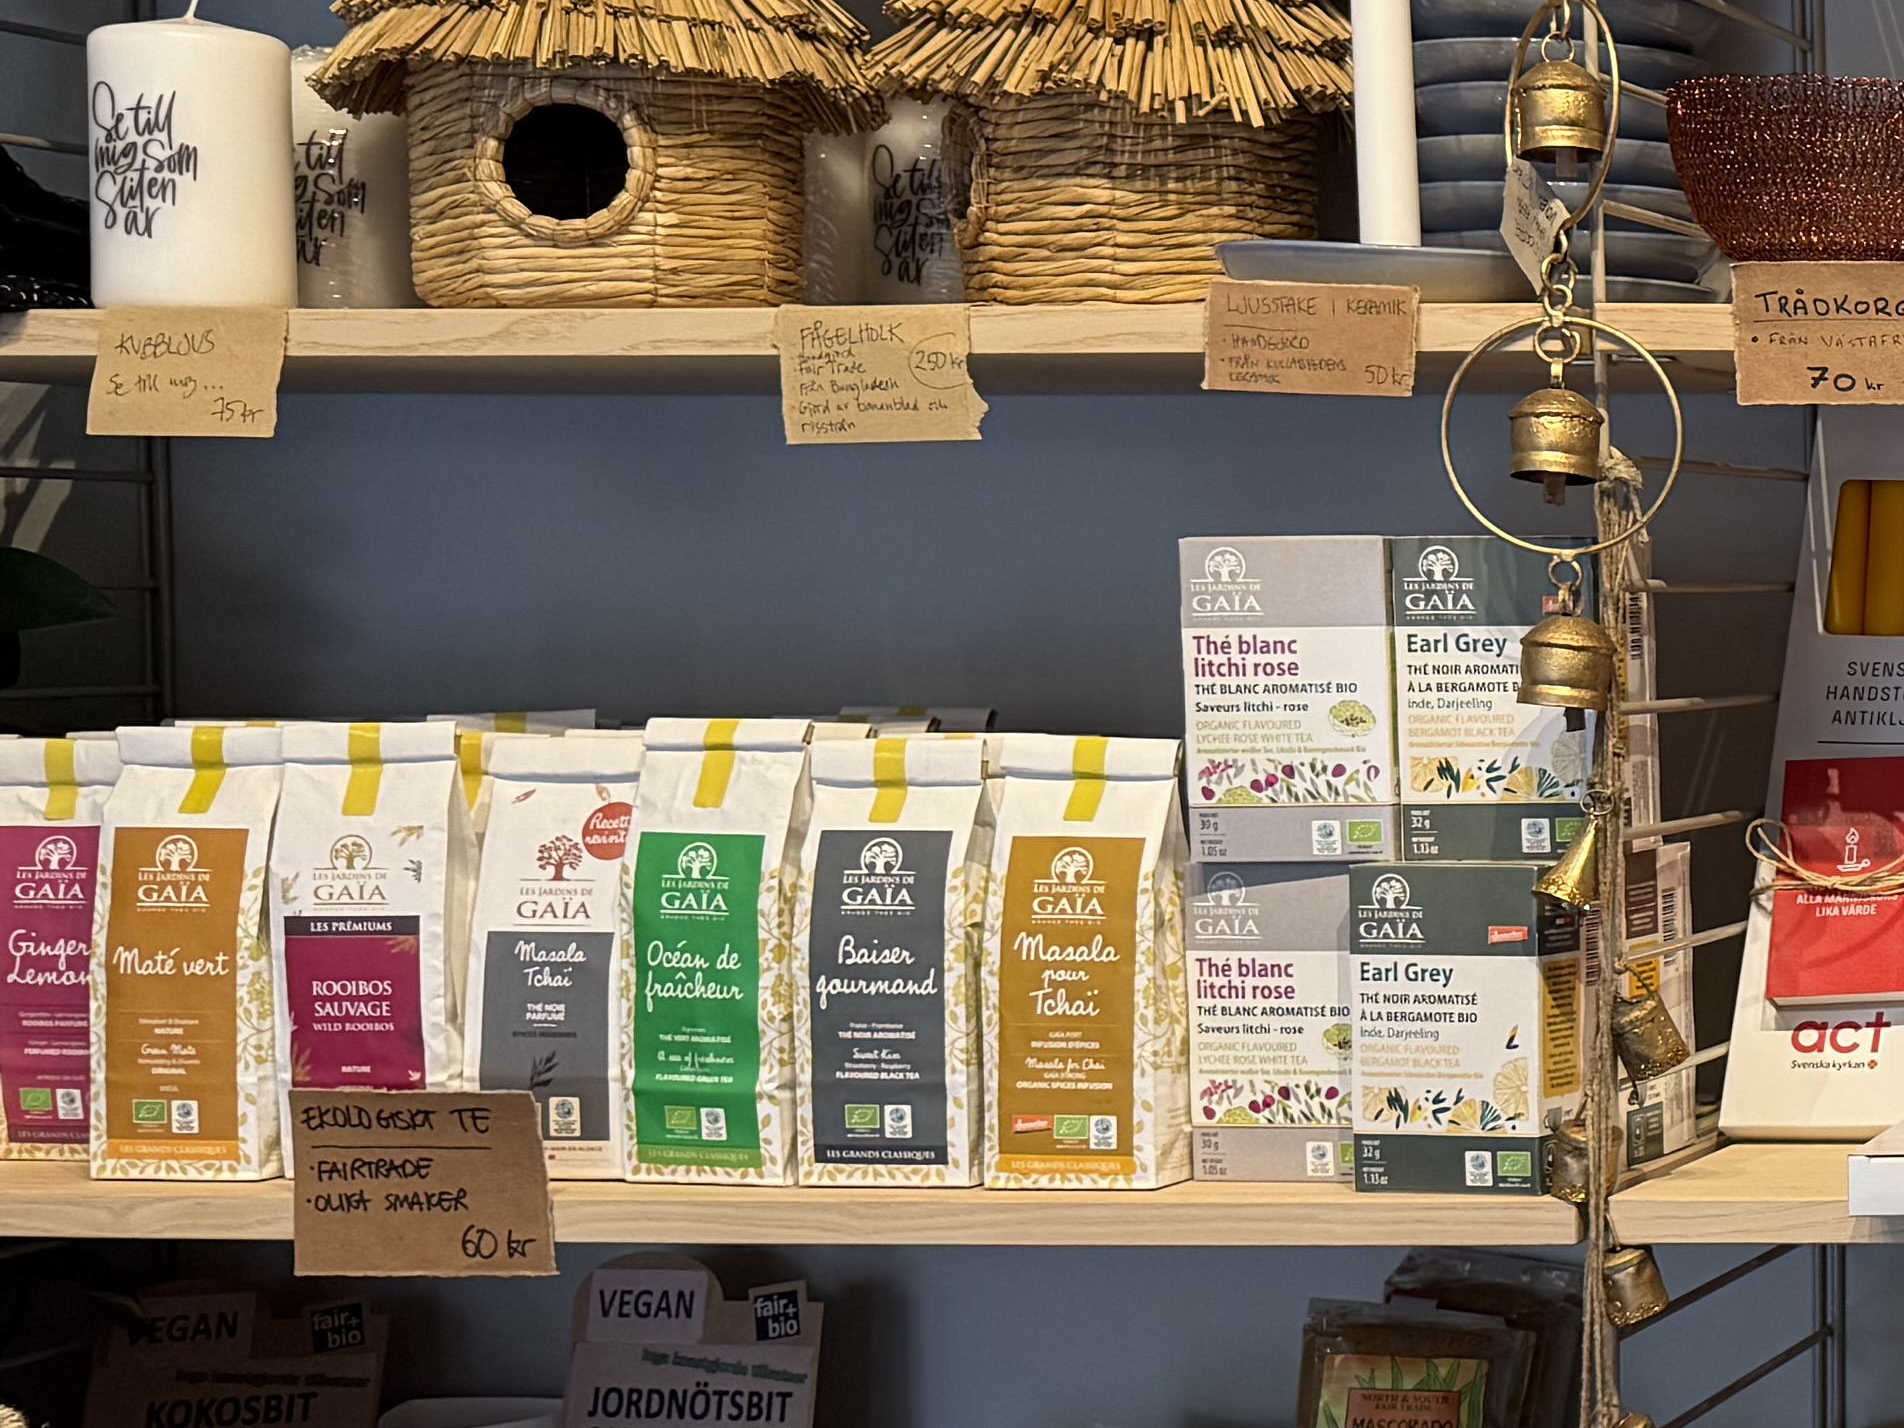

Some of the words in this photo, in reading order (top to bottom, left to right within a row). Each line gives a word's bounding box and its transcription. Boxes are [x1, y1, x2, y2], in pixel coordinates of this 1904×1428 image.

[134, 90, 177, 143] till
[125, 205, 160, 239] är
[800, 320, 905, 348] FÅGELHOLK
[1768, 331, 1810, 345] FRÅN
[1805, 365, 1858, 393] 70
[1864, 378, 1885, 391] kr
[1192, 592, 1263, 613] GAÏA
[1192, 634, 1232, 656] Thé
[1237, 634, 1298, 656] blanc
[1194, 656, 1249, 677] litchi
[1252, 660, 1300, 677] rose
[1262, 679, 1333, 695] AROMATISÉ
[1336, 683, 1357, 695] BIO
[1815, 904, 1839, 917] LIKA
[1841, 902, 1877, 916] VÄRDE
[331, 919, 392, 933] PRÉMIUMS
[8, 929, 93, 972] Ginger
[646, 940, 710, 970] Océan
[715, 942, 742, 970] de
[837, 935, 915, 966] Baiser
[1014, 932, 1120, 962] Masala
[113, 945, 180, 977] Maté
[183, 953, 230, 978] vert
[1359, 960, 1399, 982] Earl
[1404, 961, 1454, 987] Grey
[311, 979, 392, 997] ROOIBOS
[815, 967, 938, 1010] gourmand
[1042, 968, 1089, 984] pour
[644, 970, 743, 1012] fraîcheur
[1029, 987, 1100, 1017] Tchaï
[314, 999, 391, 1018] SAUVAGE
[1382, 1010, 1452, 1024] BERGAMOTE
[301, 1105, 438, 1131] EKOLOGISKT
[450, 1107, 491, 1134] TE
[315, 1156, 434, 1180] FAIRTRADE
[314, 1190, 373, 1212] OLIKA
[385, 1189, 469, 1211] SMAKER
[460, 1224, 498, 1258] 60
[506, 1228, 537, 1259] kr
[598, 1287, 695, 1320] VEGAN
[586, 1381, 793, 1423] JORDNÖTSBIT
